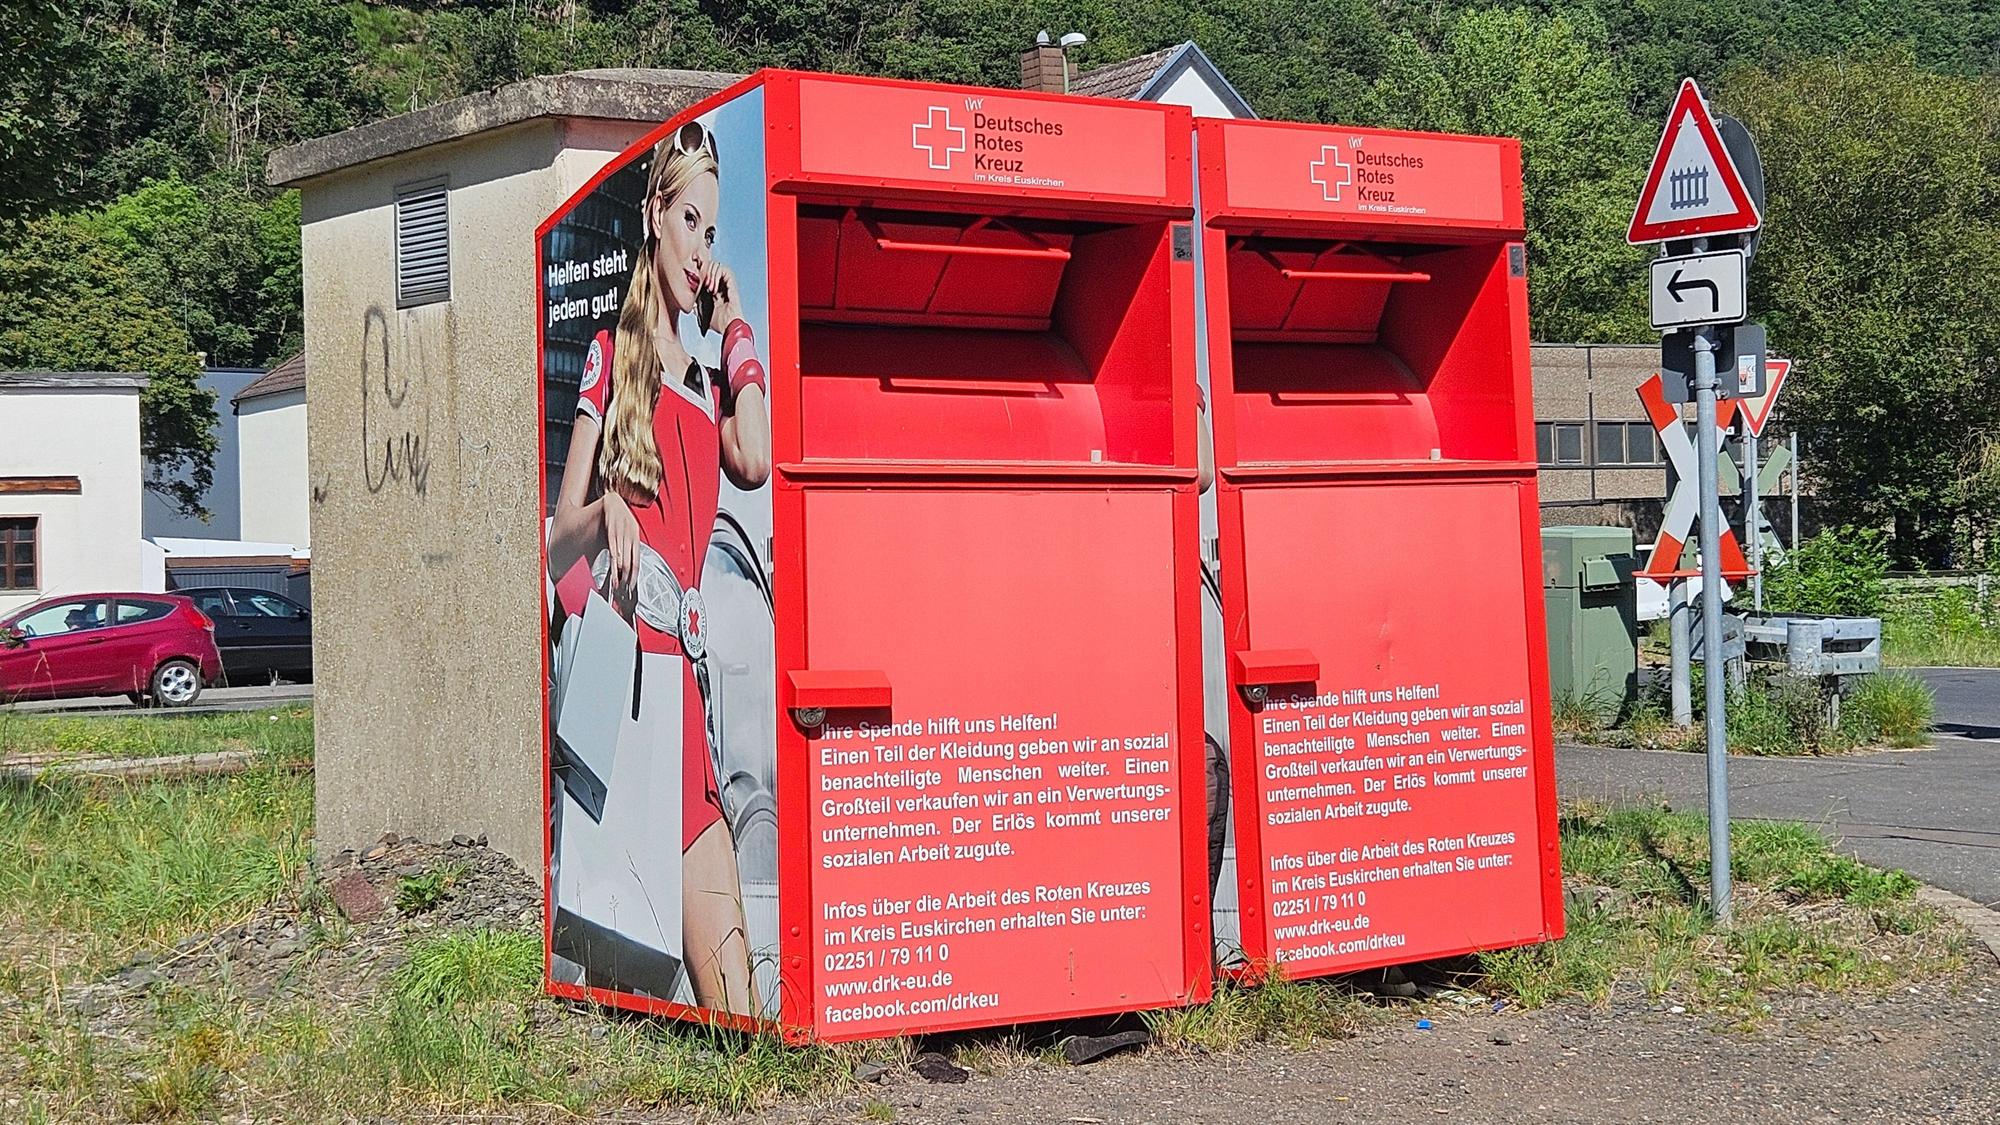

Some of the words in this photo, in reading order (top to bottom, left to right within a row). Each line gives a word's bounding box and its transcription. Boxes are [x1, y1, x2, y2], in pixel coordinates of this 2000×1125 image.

[974, 113, 1063, 136] Deutsches
[975, 134, 1023, 152] Rotes
[975, 154, 1023, 172] Kreuz
[1356, 150, 1424, 168] Deutsches
[1358, 169, 1394, 184] Rotes
[1358, 187, 1395, 202] Kreuz
[548, 260, 590, 287] Helfen
[593, 249, 627, 278] steht
[548, 297, 588, 328] jedem
[592, 287, 618, 319] gut!
[1291, 692, 1339, 711] Spende
[1342, 689, 1367, 705] hilft
[1370, 690, 1393, 703] uns
[1396, 684, 1439, 701] Helfen!
[821, 723, 853, 739] Ihre
[859, 720, 922, 741] Spende
[928, 717, 960, 735] hilft
[965, 720, 995, 733] uns
[1001, 713, 1057, 732] Helfen!
[1263, 718, 1300, 734] Einen
[1303, 714, 1326, 730] Teil
[1329, 714, 1350, 728] der
[1352, 710, 1408, 726] Kleidung
[1411, 706, 1448, 726] geben
[1451, 704, 1470, 718] wir
[1472, 706, 1487, 717] an
[1490, 699, 1524, 716] sozial
[821, 748, 869, 766] Einen
[874, 745, 903, 762] Teil
[908, 744, 936, 761] der
[940, 741, 1014, 760] Kleidung
[1019, 738, 1068, 760] geben
[1072, 736, 1097, 752] wir
[1101, 738, 1120, 751] an
[1124, 732, 1168, 750] sozial
[1264, 736, 1355, 756] benachteiligte
[1367, 730, 1430, 748] Menschen
[1441, 726, 1480, 741] weiter.
[1492, 722, 1525, 737] Einen
[822, 769, 941, 791] benachteiligte
[958, 764, 1042, 783] Menschen
[1058, 761, 1110, 778] weiter.
[1126, 758, 1169, 774] Einen
[1266, 760, 1318, 779] Großteil
[1320, 756, 1384, 774] verkaufen
[1386, 753, 1406, 768] wir
[1408, 754, 1424, 766] an
[1427, 750, 1445, 764] ein
[1448, 746, 1526, 762] Verwertungs-
[1267, 783, 1356, 802] unternehmen.
[1364, 778, 1386, 792] Der
[1394, 773, 1426, 790] Erlös
[1434, 769, 1476, 786] kommt
[1482, 766, 1528, 781] unserer
[822, 796, 890, 817] Großteil
[896, 792, 978, 812] verkaufen
[983, 790, 1009, 806] wir
[1013, 792, 1032, 805] an
[1037, 787, 1062, 804] ein
[1066, 784, 1170, 802] Verwertungs-
[1268, 807, 1322, 825] sozialen
[1325, 802, 1364, 819] Arbeit
[1366, 798, 1412, 817] zugute.
[822, 822, 940, 842] unternehmen.
[952, 817, 982, 834] Der
[992, 813, 1035, 831] Erlös
[1046, 809, 1101, 828] kommt
[1111, 808, 1171, 824] unserer
[823, 848, 894, 868] sozialen
[898, 844, 950, 862] Arbeit
[954, 840, 1014, 862] zugute.
[1271, 854, 1304, 871] Infos
[1307, 851, 1336, 867] über
[1339, 848, 1358, 863] die
[1361, 842, 1399, 860] Arbeit
[1402, 840, 1424, 856] des
[1428, 837, 1464, 852] Roten
[1467, 832, 1515, 848] Kreuzes
[1272, 879, 1288, 894] im
[1292, 874, 1326, 891] Kreis
[1329, 866, 1400, 887] Euskirchen
[1402, 860, 1452, 878] erhalten
[1456, 856, 1475, 871] Sie
[1478, 854, 1512, 868] unter:
[824, 901, 867, 920] Infos
[873, 898, 912, 916] über
[916, 895, 942, 912] die
[946, 890, 997, 910] Arbeit
[1001, 888, 1030, 905] des
[1035, 886, 1082, 902] Roten
[1088, 882, 1150, 898] Kreuzes
[1273, 898, 1310, 917] 02251
[1315, 897, 1319, 912] /
[1322, 894, 1337, 910] 79
[1341, 892, 1354, 908] 11
[1358, 891, 1366, 906] 0
[825, 929, 845, 946] im
[851, 924, 896, 943] Kreis
[901, 917, 995, 939] Euskirchen
[1000, 911, 1066, 930] erhalten
[1071, 907, 1096, 924] Sie
[1100, 905, 1146, 922] unter:
[1274, 914, 1370, 940] www.drk-eu.de
[825, 950, 873, 971] 02251
[880, 949, 886, 966] /
[890, 948, 910, 965] 79
[916, 945, 932, 962] 11
[939, 944, 948, 961] 0
[1275, 933, 1405, 963] facebook.com/drkeu
[825, 970, 952, 997] www.drk-eu.de
[825, 992, 998, 1023] facebook.com/drkeu
